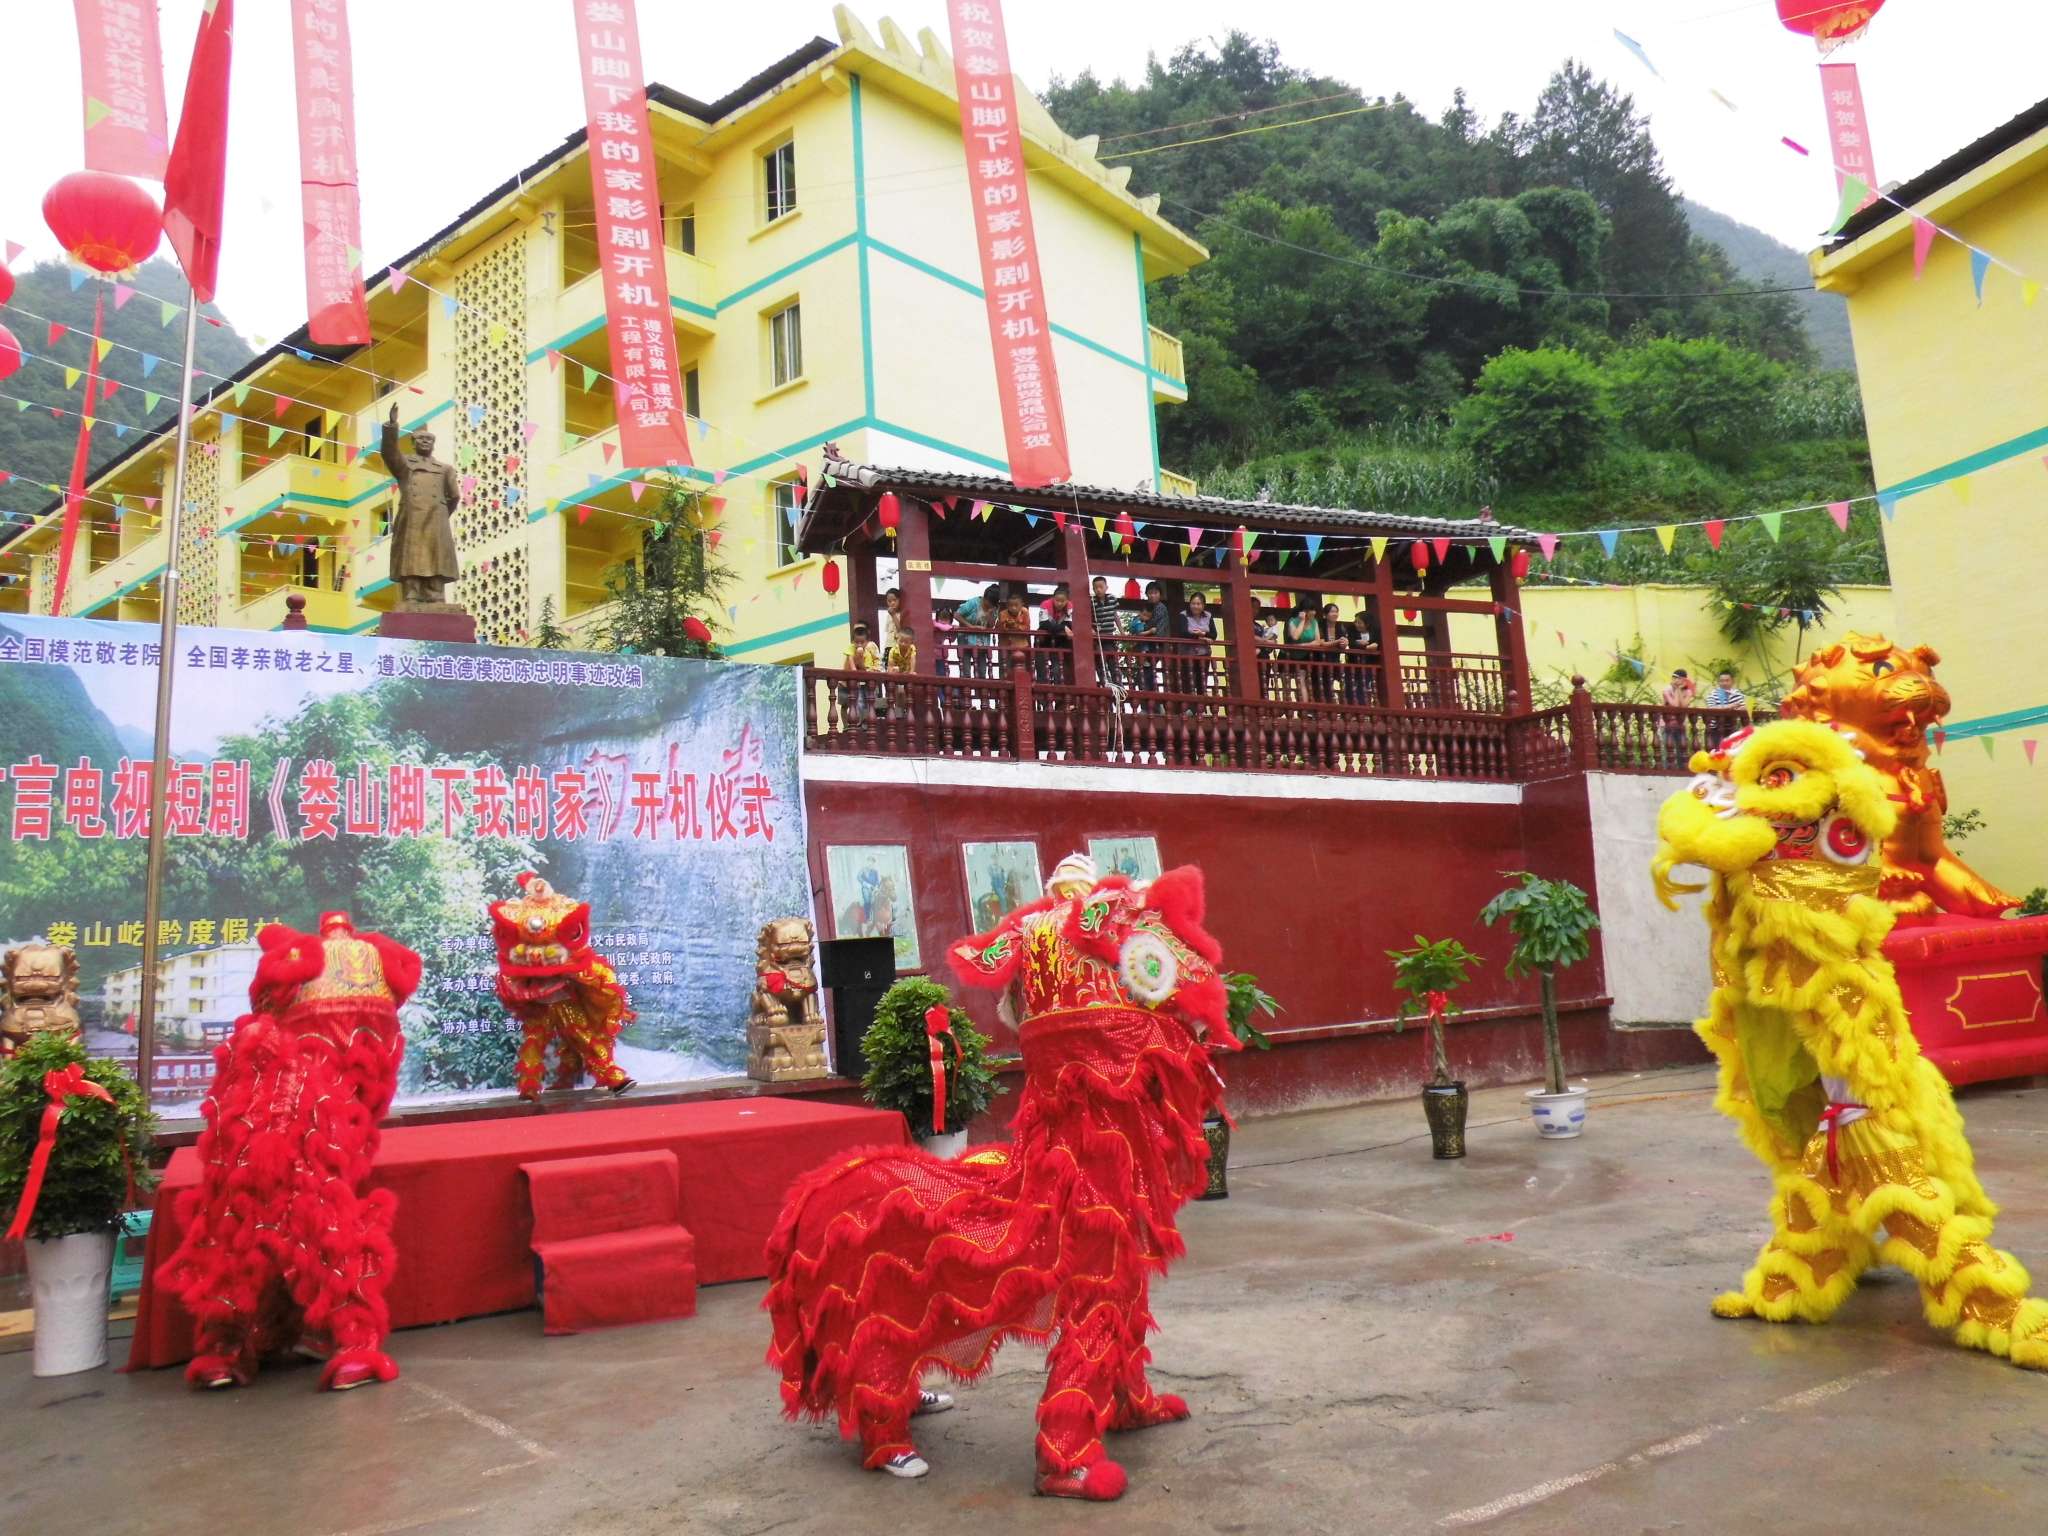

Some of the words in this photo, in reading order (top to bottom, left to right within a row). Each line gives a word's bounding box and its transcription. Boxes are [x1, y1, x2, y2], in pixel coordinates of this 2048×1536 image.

[585, 2, 660, 307] 娄山脚下我的家影剧开机
[959, 2, 1040, 340] 祝贺娄山脚下我的家影剧开机
[620, 316, 650, 411] 工程有限公司
[643, 319, 675, 409] 遵义市第一建筑
[637, 411, 670, 428] 贺
[1023, 433, 1052, 449] 贺
[0, 637, 161, 666] 全国模范敬老院
[0, 754, 775, 842] 言电视短剧《娄山脚下我的家》开机仪式
[46, 917, 283, 948] 娄山屹黔度假
[596, 951, 673, 966] 川区人民政府
[613, 971, 674, 985] 党委、政府
